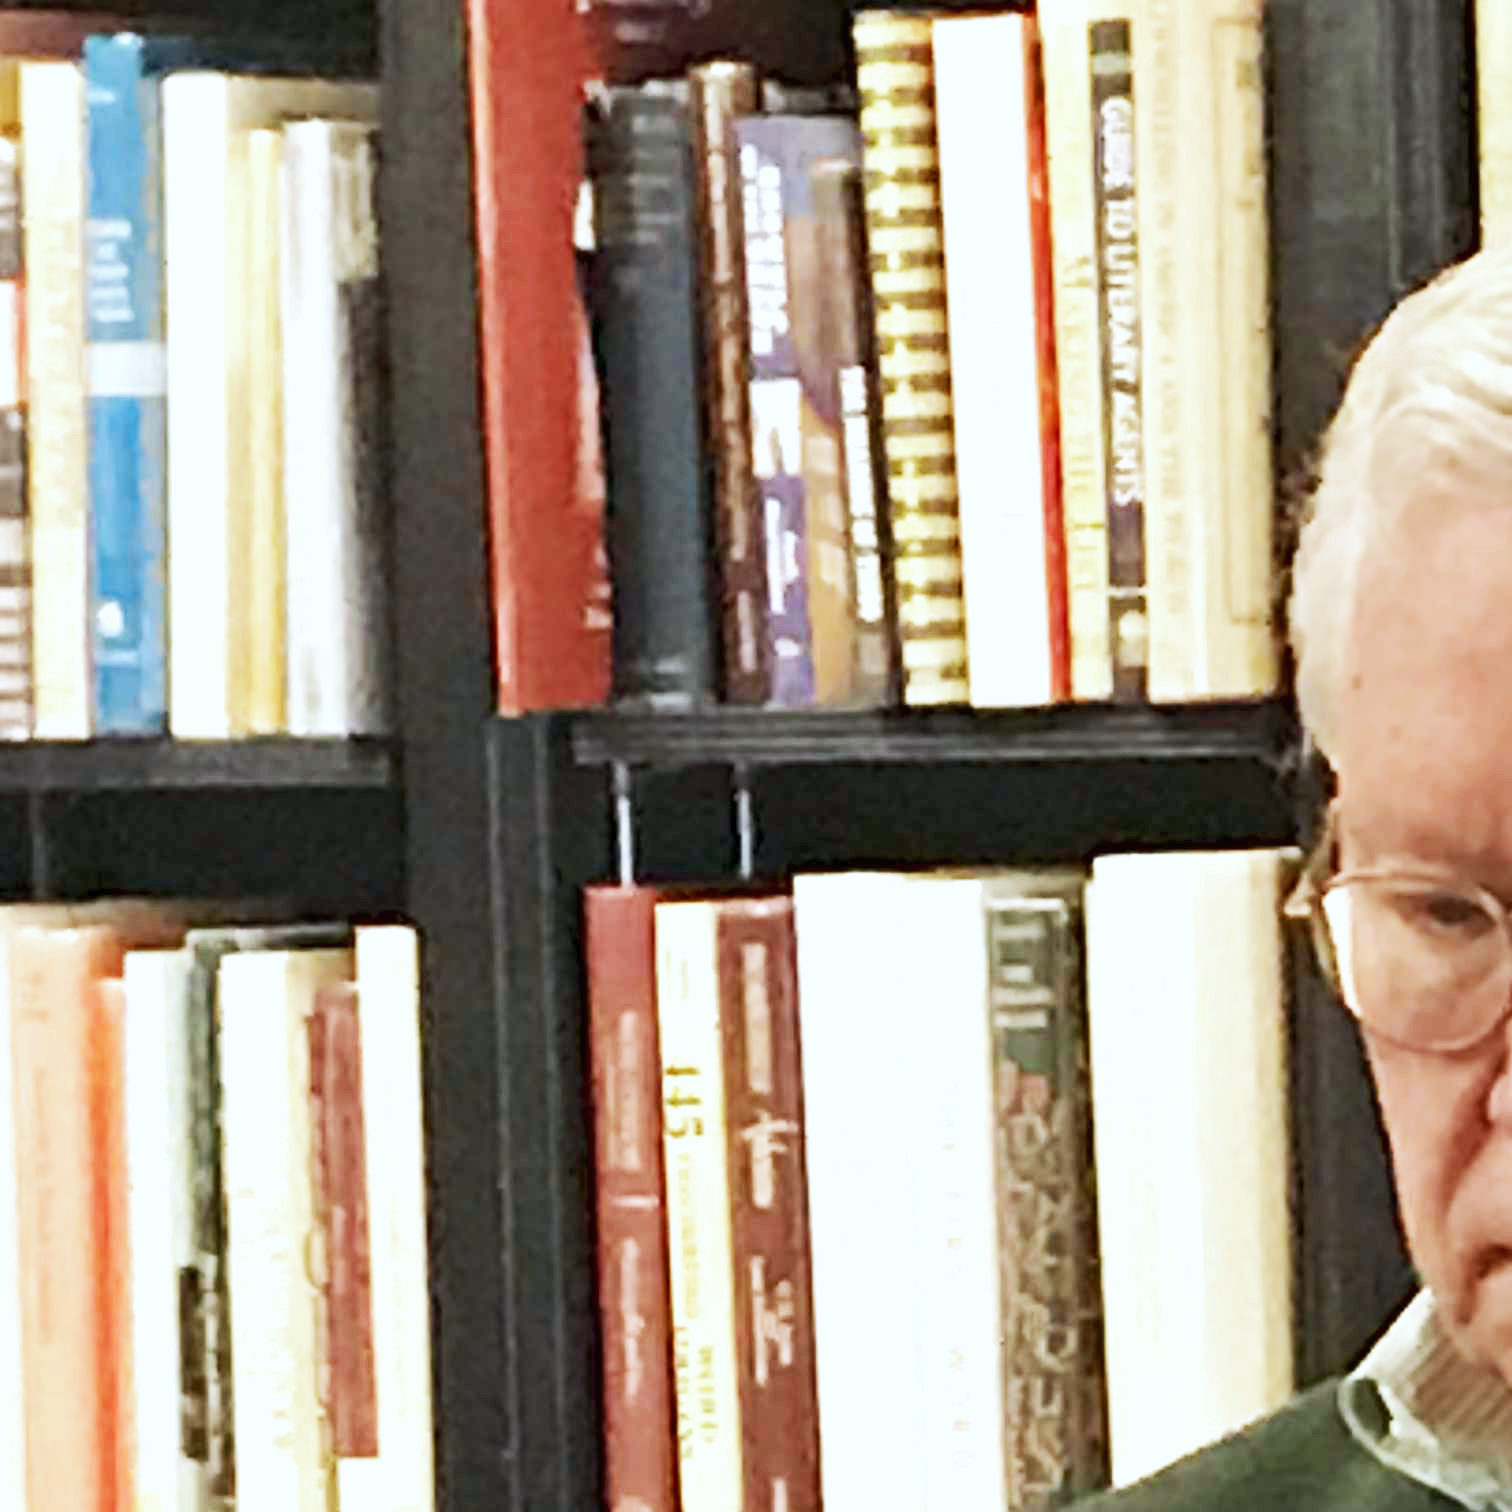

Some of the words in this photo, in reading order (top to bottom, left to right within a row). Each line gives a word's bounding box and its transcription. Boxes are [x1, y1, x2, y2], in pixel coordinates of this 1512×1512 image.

[1100, 95, 1135, 190] GUIDE
[1106, 199, 1134, 237] TO
[1107, 242, 1140, 384] LITERARY
[1113, 390, 1144, 507] AGENTS
